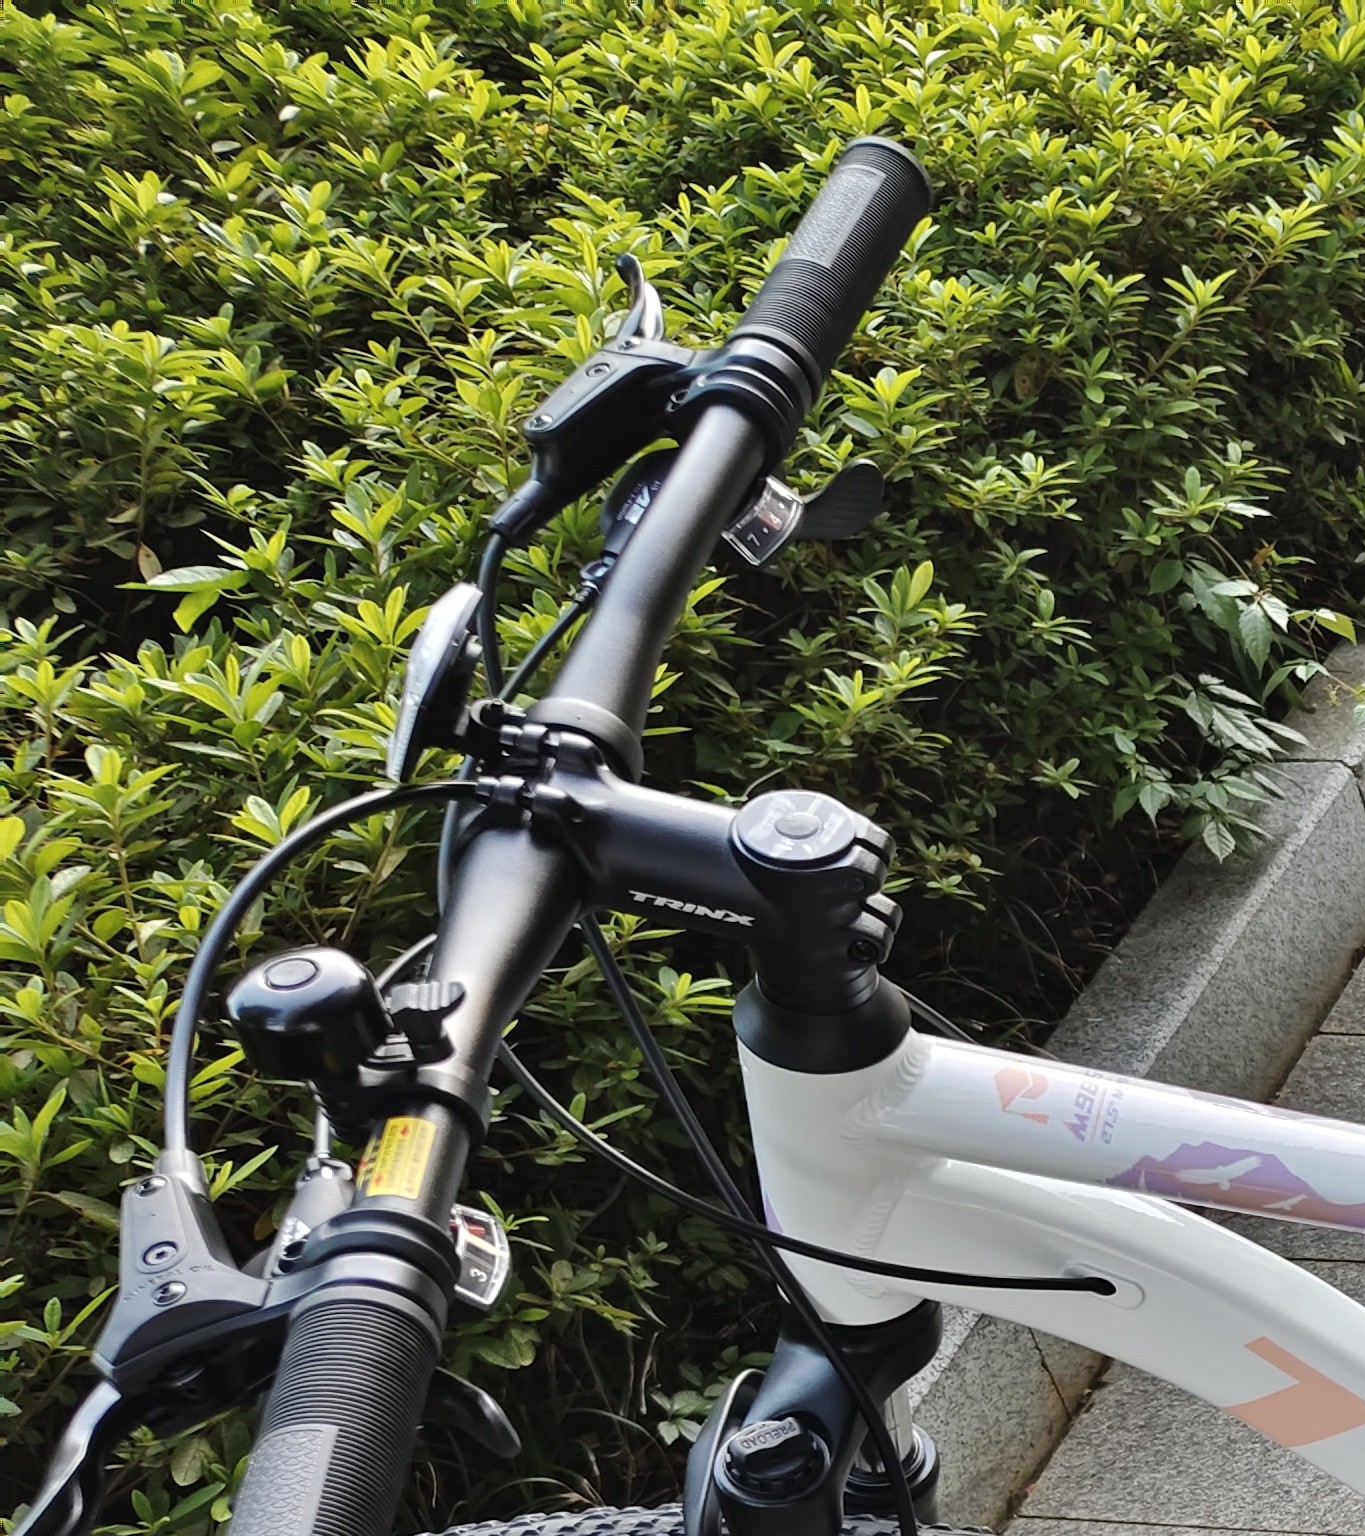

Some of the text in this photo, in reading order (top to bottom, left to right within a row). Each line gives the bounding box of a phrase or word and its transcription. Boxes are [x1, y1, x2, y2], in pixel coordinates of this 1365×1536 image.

[629, 890, 755, 926] TRINX
[468, 1266, 488, 1283] 3
[740, 1421, 797, 1450] PRELOAD
